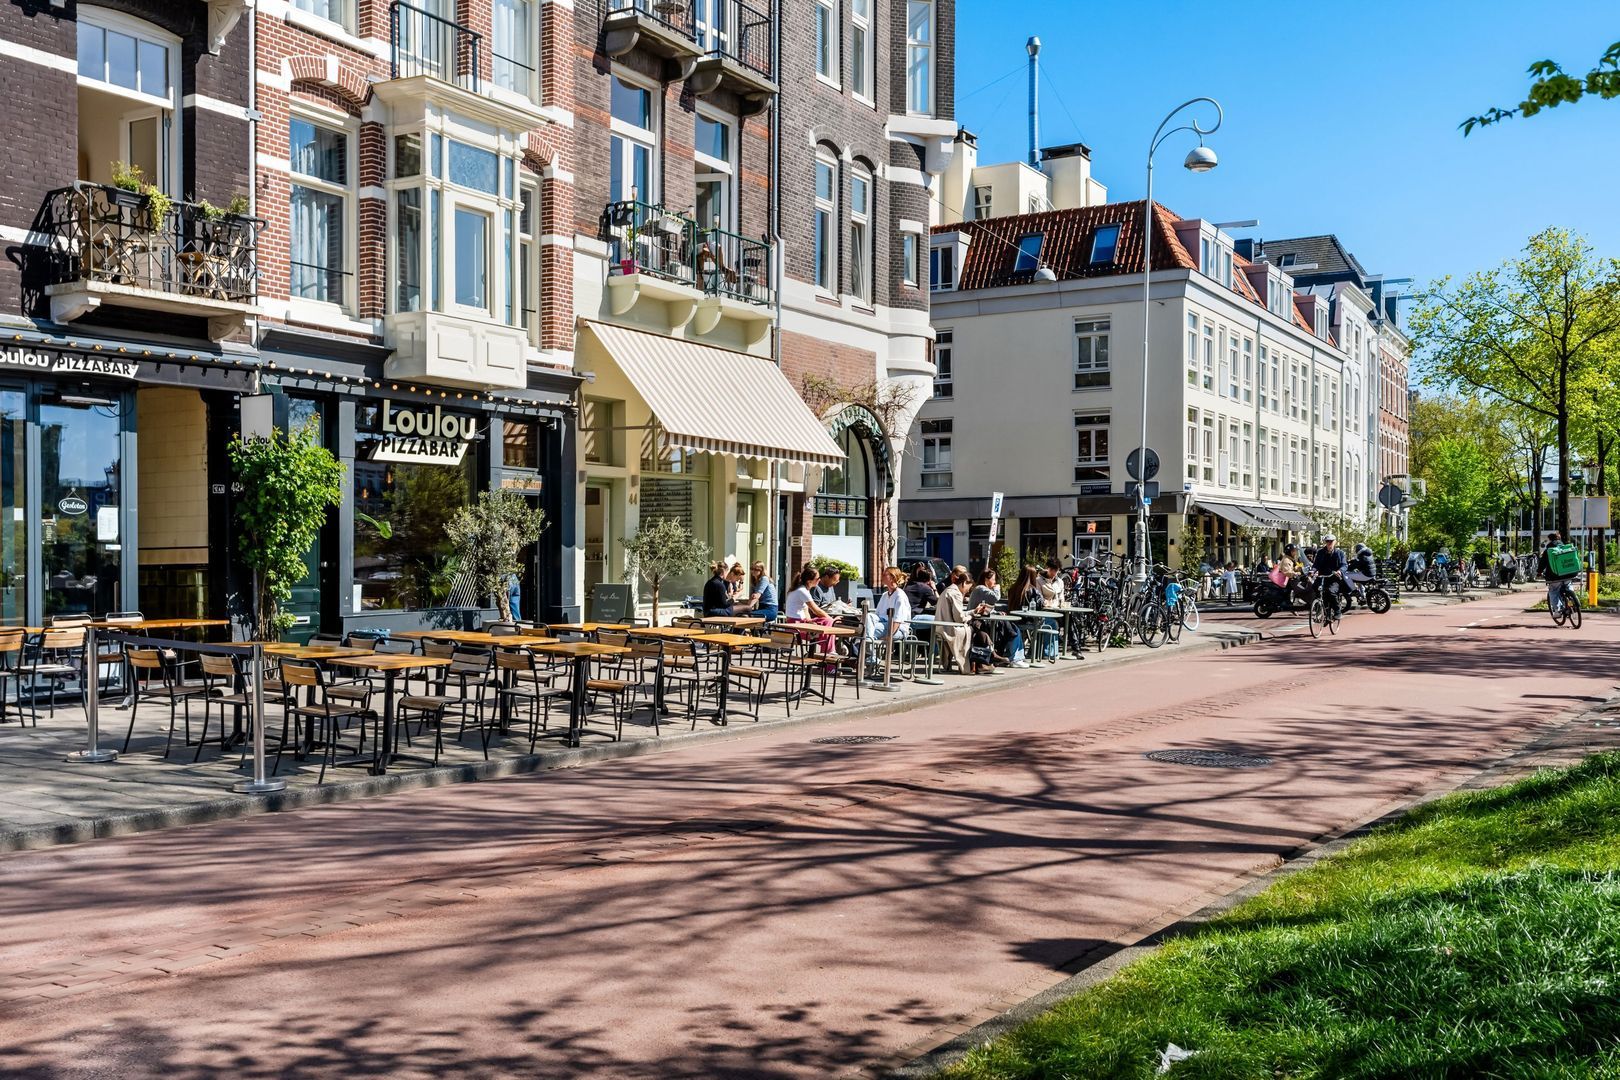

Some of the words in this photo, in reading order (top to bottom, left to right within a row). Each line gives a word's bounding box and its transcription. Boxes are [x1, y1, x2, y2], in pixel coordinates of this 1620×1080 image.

[57, 358, 131, 375] PIZZABAR
[382, 399, 476, 440] Loulou
[243, 436, 271, 446] Lolou
[381, 437, 459, 458] PIZZABAR
[61, 501, 85, 510] Gesloten
[628, 492, 638, 505] 44
